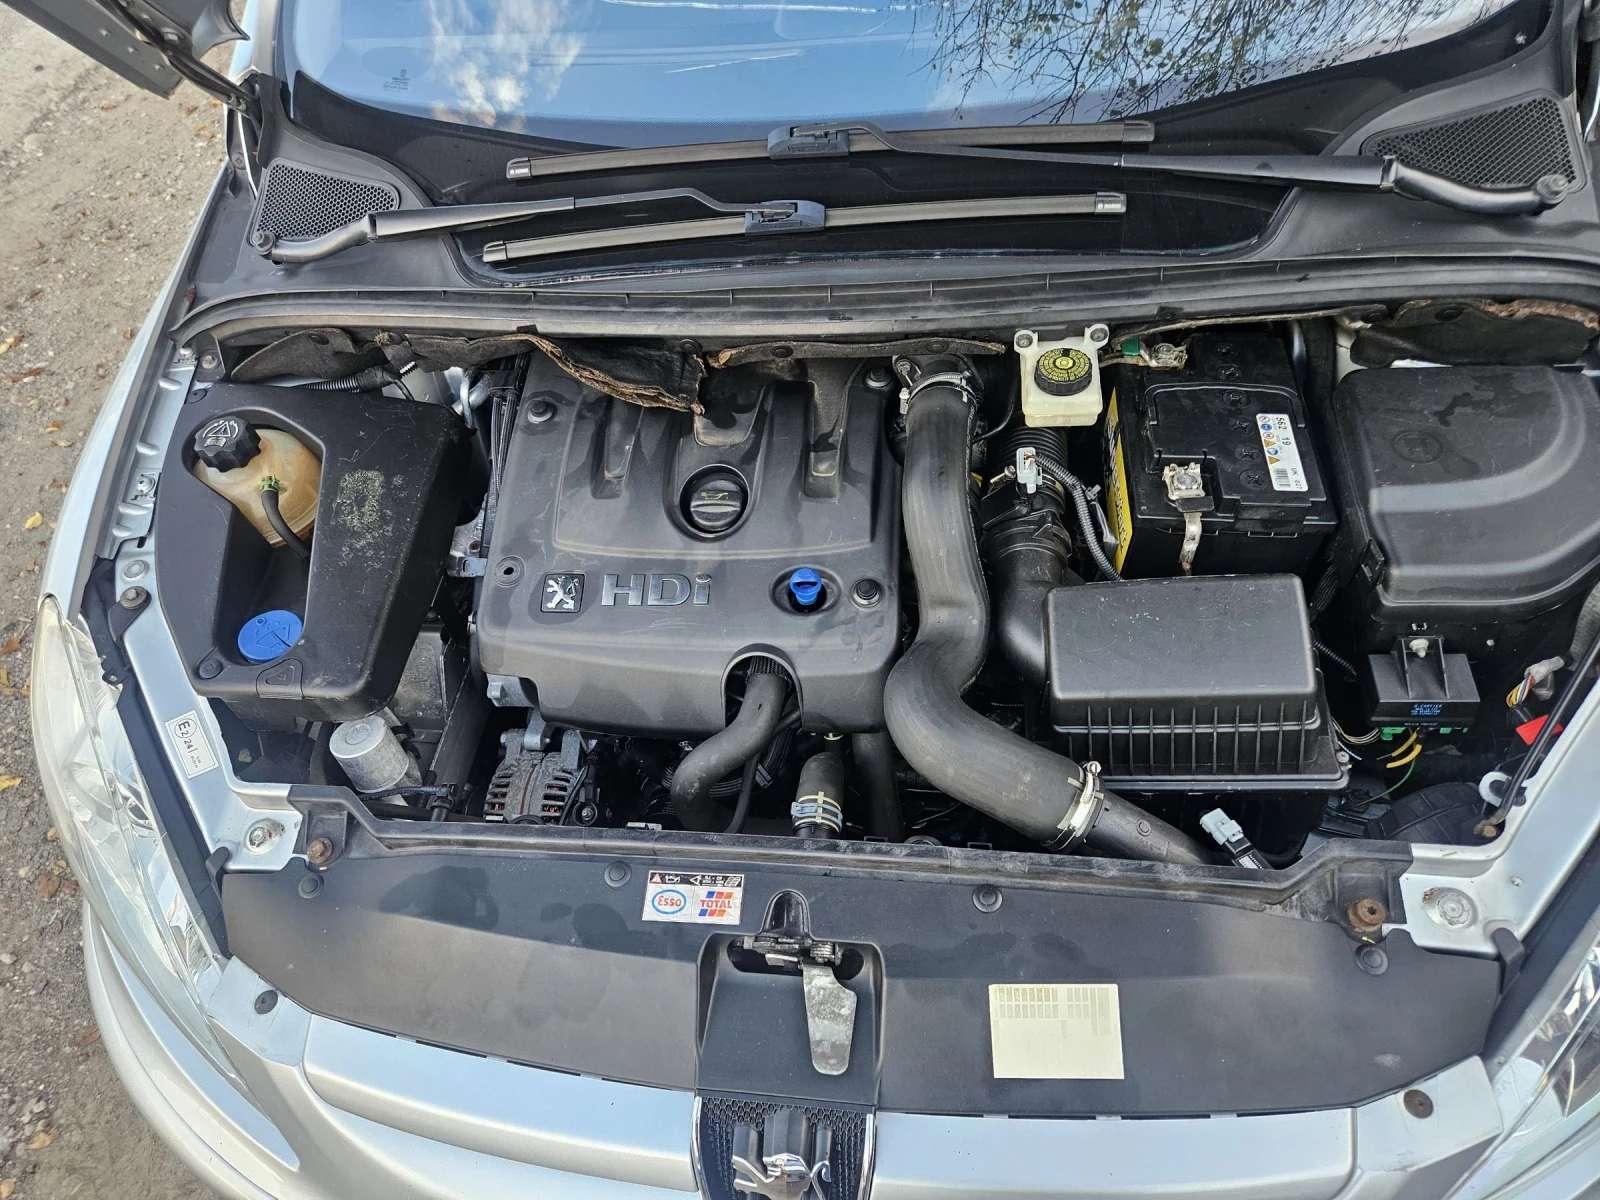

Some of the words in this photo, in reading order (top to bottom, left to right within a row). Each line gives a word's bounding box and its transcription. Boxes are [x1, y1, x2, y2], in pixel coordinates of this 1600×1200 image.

[1276, 417, 1288, 430] 562
[1282, 437, 1292, 446] 19
[601, 573, 712, 606] HDi
[184, 738, 194, 749] 24
[700, 899, 732, 909] TOTAL
